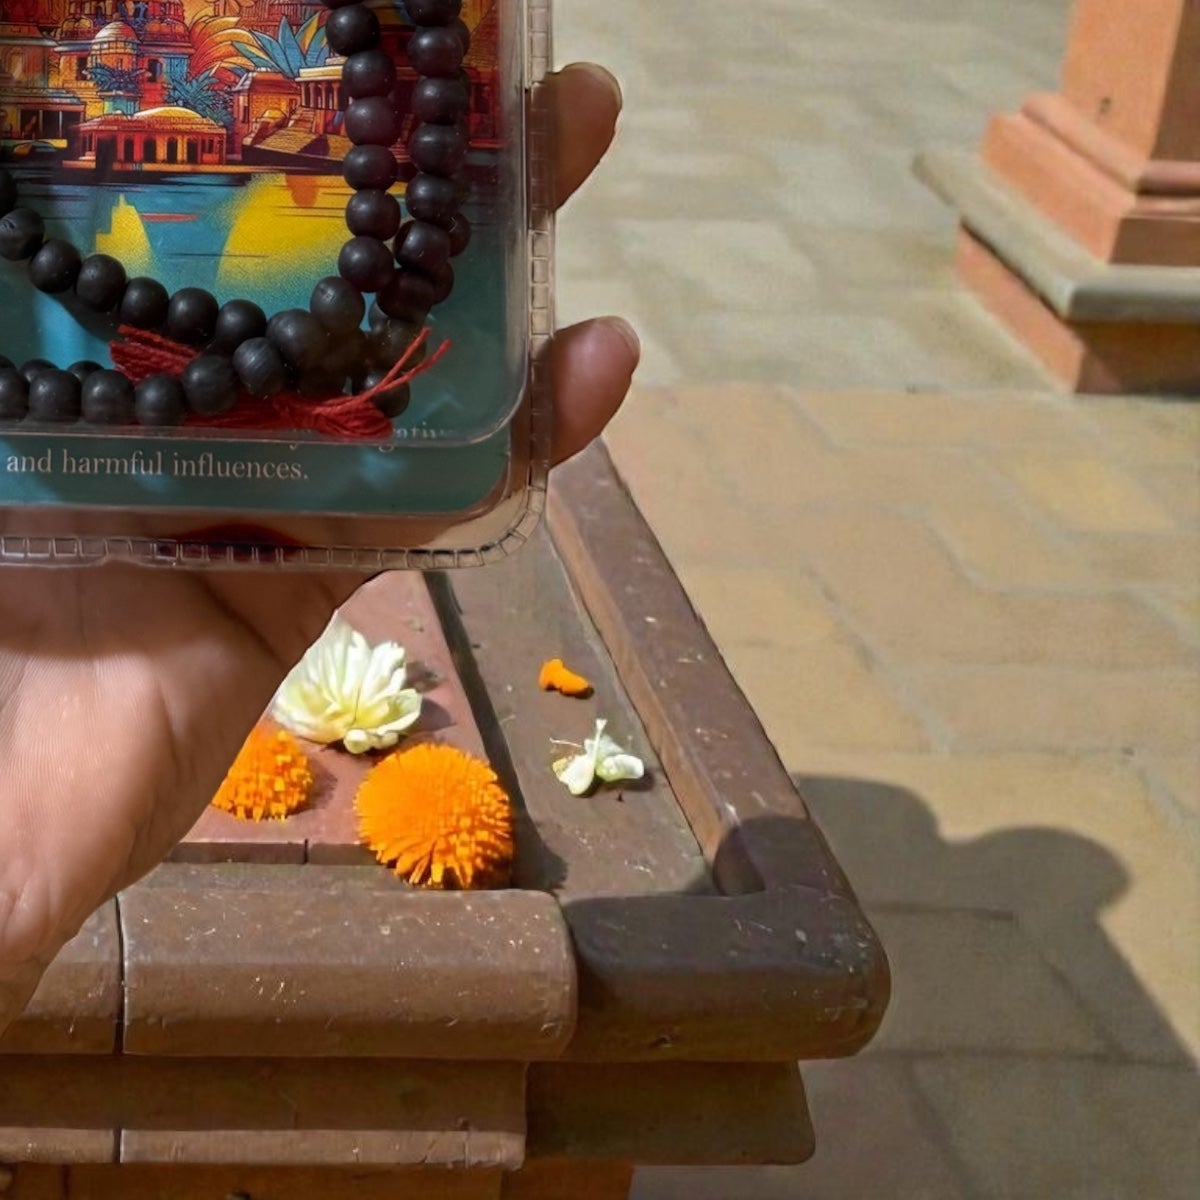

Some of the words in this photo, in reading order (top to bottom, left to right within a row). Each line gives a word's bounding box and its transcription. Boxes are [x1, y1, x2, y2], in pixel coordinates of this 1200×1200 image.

[6, 448, 52, 473] and
[62, 448, 163, 476] harmful
[173, 452, 310, 480] influences.
